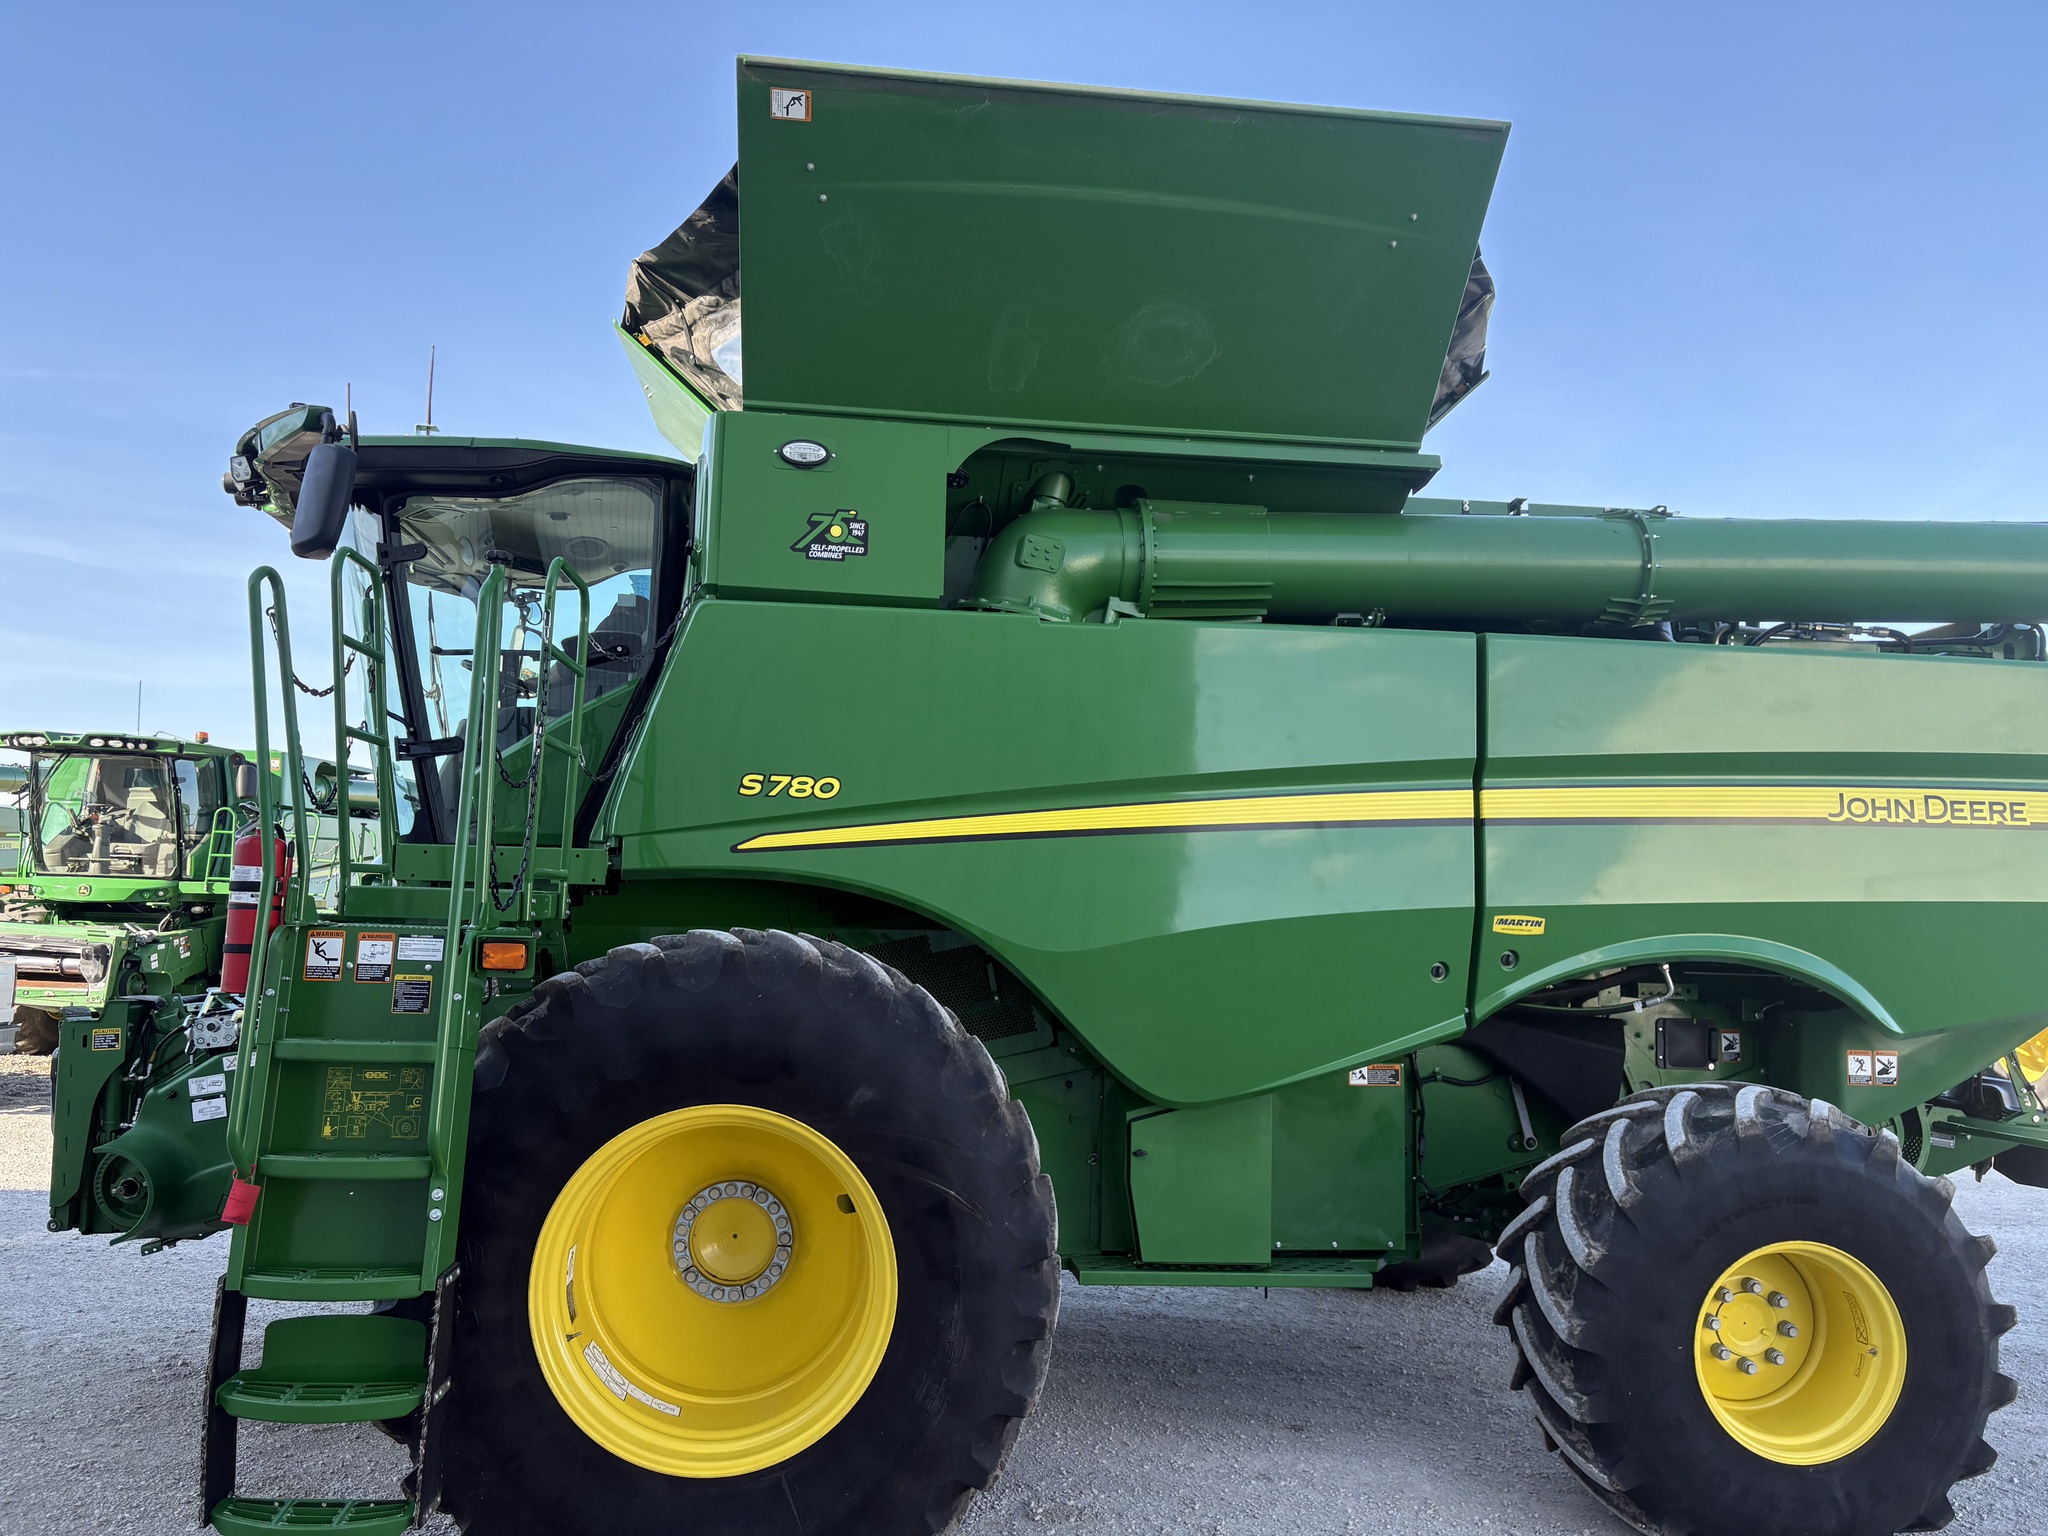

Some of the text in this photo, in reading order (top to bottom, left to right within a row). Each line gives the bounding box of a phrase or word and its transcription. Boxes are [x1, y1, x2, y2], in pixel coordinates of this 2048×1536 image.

[810, 543, 865, 554] SELF-PROPELLED
[808, 551, 843, 559] COMBINES
[1828, 792, 2028, 823] JOHN DEERE
[1497, 918, 1543, 927] MARTIN
